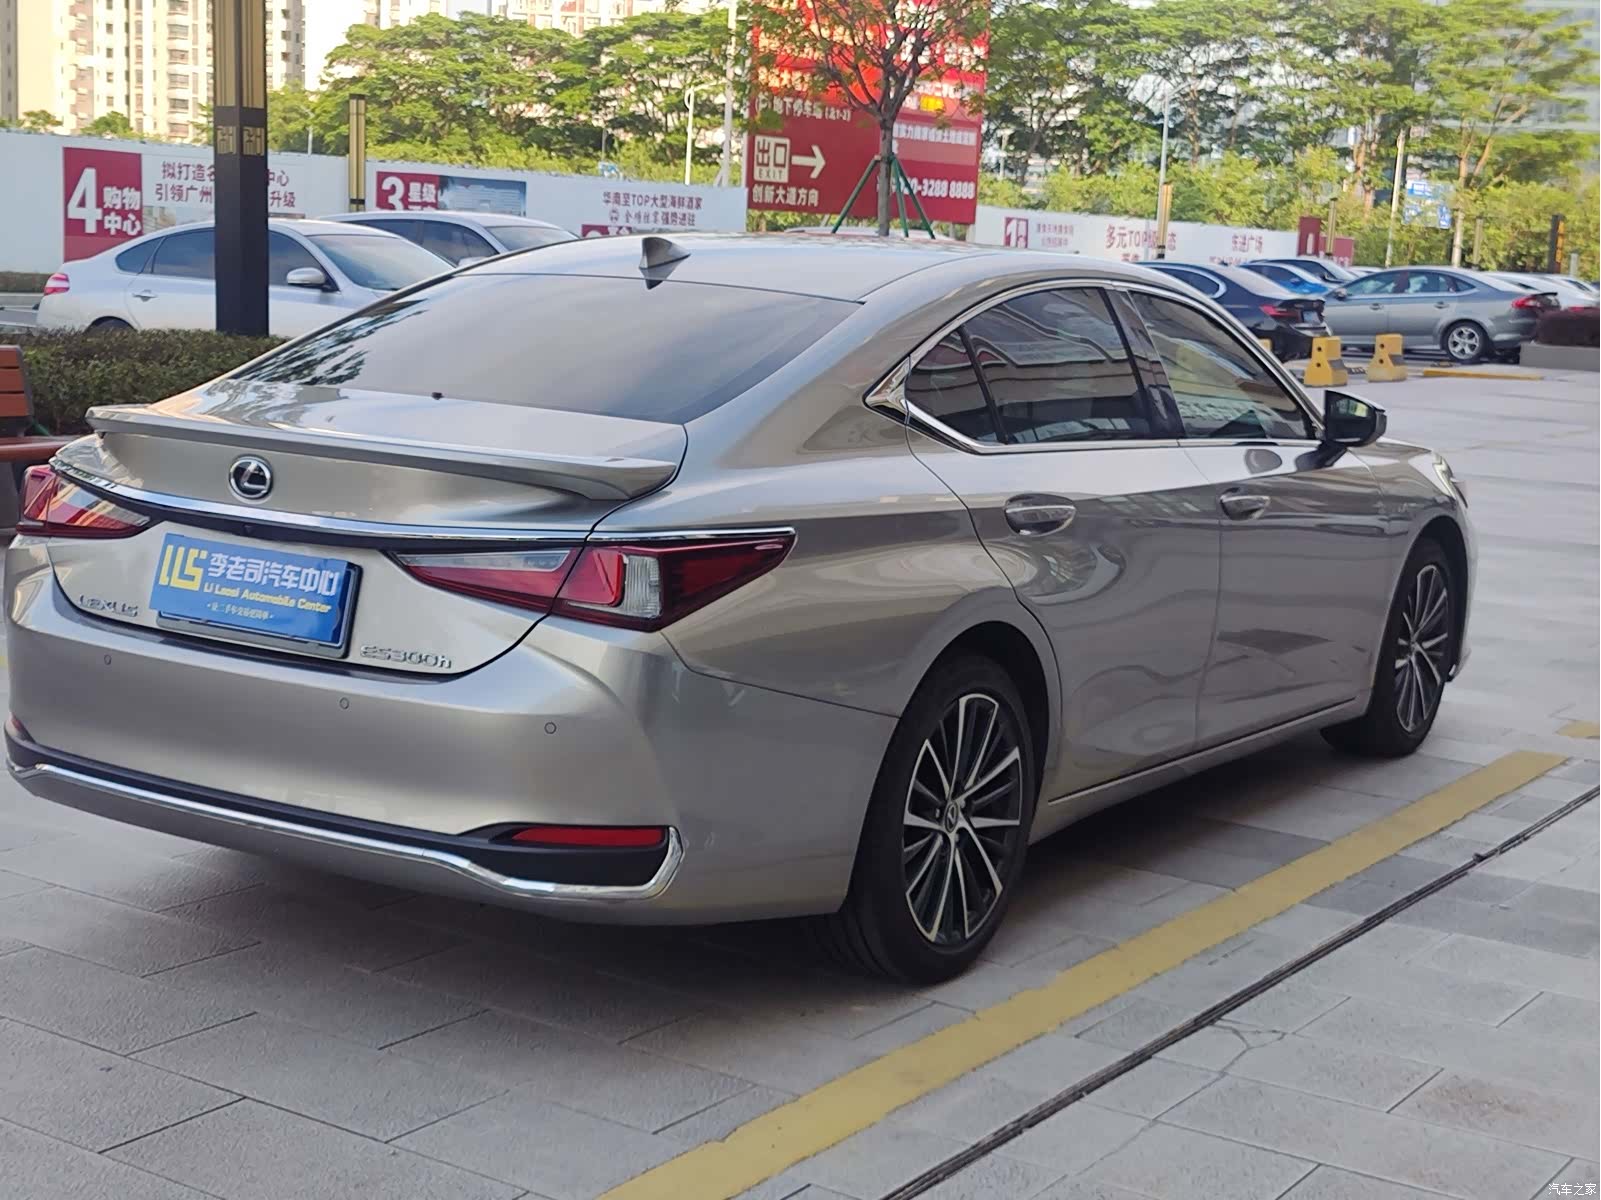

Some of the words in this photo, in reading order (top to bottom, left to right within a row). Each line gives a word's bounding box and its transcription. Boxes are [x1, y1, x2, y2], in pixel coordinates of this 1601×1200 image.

[756, 139, 788, 168] 出口
[758, 168, 782, 180] EXIT
[67, 167, 102, 233] 4
[104, 186, 141, 209] 购物
[382, 176, 405, 210] 3
[752, 184, 819, 207] 创新大道方向
[104, 214, 142, 236] 中心
[208, 552, 340, 596] 李老司汽车中心
[241, 589, 296, 607] Automobile
[297, 598, 332, 613] Center
[361, 644, 452, 669] ES300h
